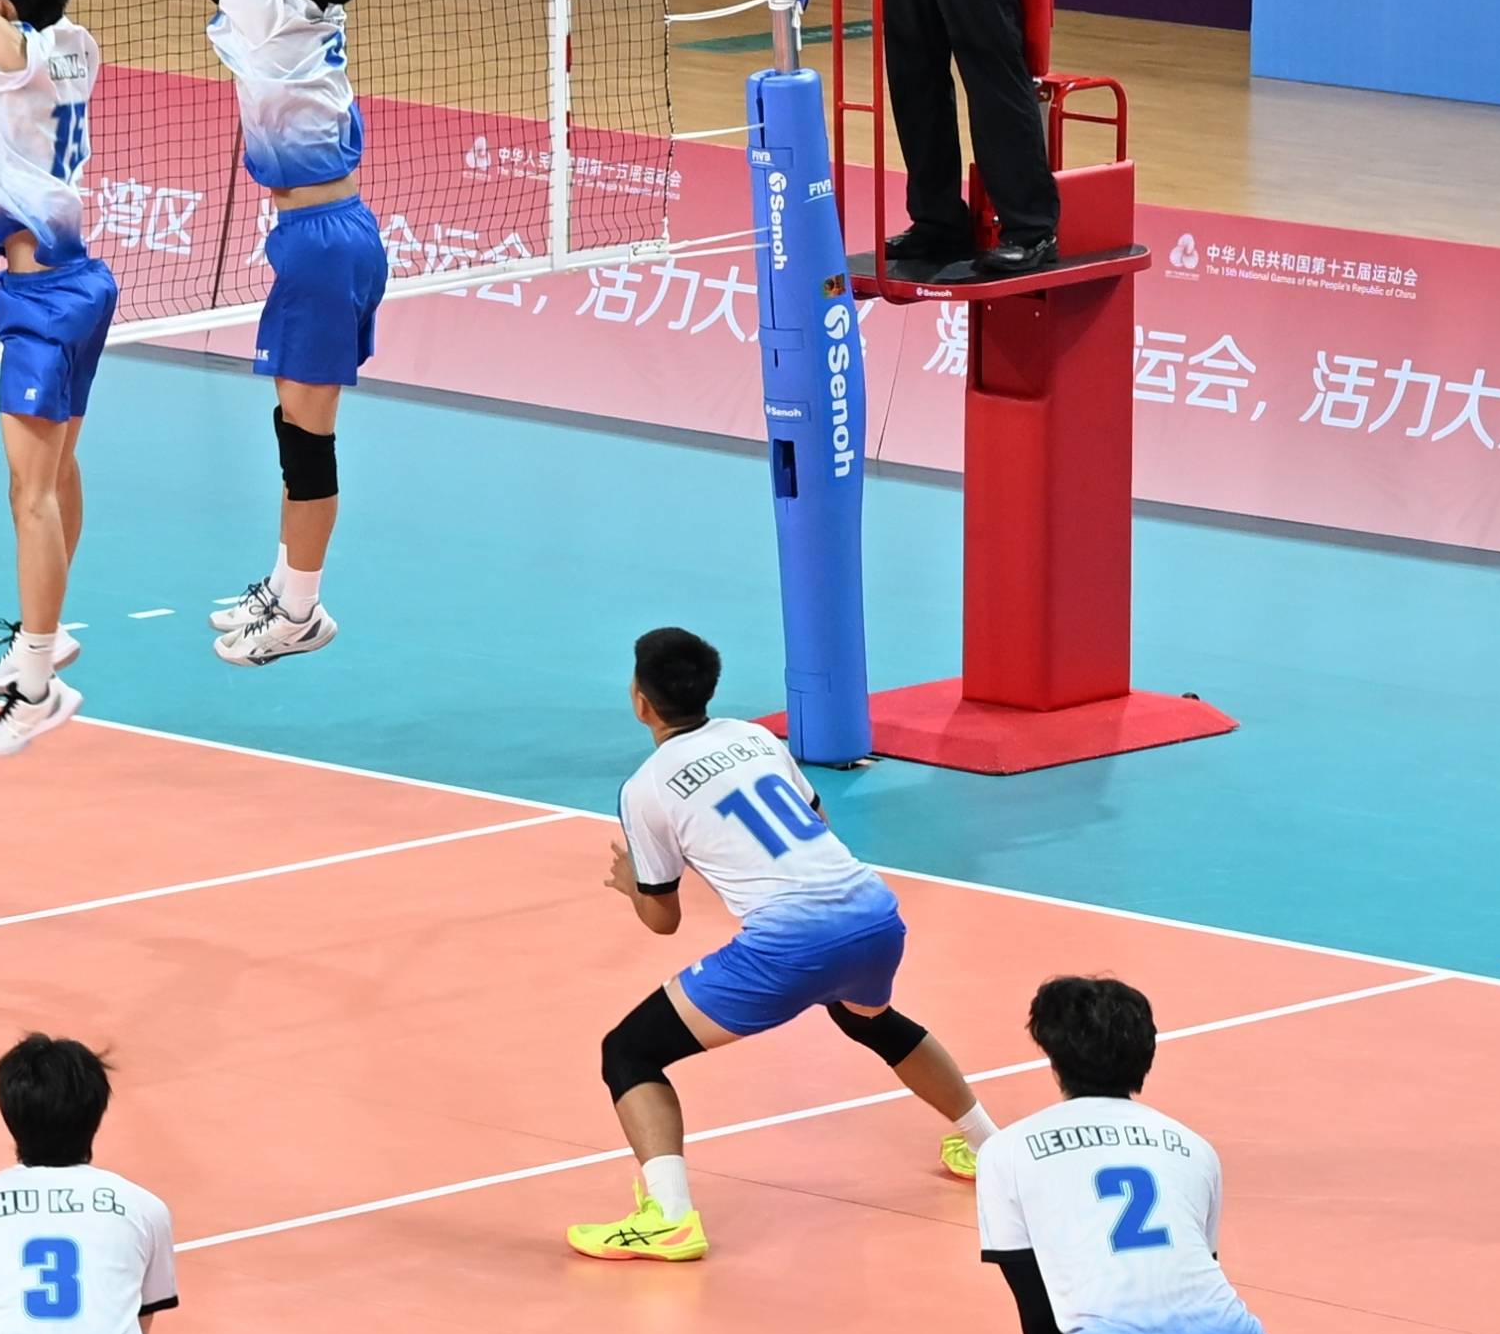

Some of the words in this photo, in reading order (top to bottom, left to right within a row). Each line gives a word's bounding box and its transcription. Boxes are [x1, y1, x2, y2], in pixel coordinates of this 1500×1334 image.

[769, 195, 787, 270] Senoh
[1207, 244, 1418, 287] 中华人民共和国第十五届运动会
[770, 406, 801, 418] Senoh
[827, 343, 854, 478] Senoh
[666, 751, 735, 800] IEONG
[728, 743, 759, 761] C.
[714, 774, 828, 859] 10
[1026, 1125, 1120, 1160] LEONG
[1124, 1126, 1158, 1146] H.
[1163, 1129, 1190, 1157] P.
[48, 1189, 84, 1213] K.
[93, 1188, 125, 1216] S.
[1092, 1164, 1173, 1255] 2
[22, 1237, 82, 1320] 3
